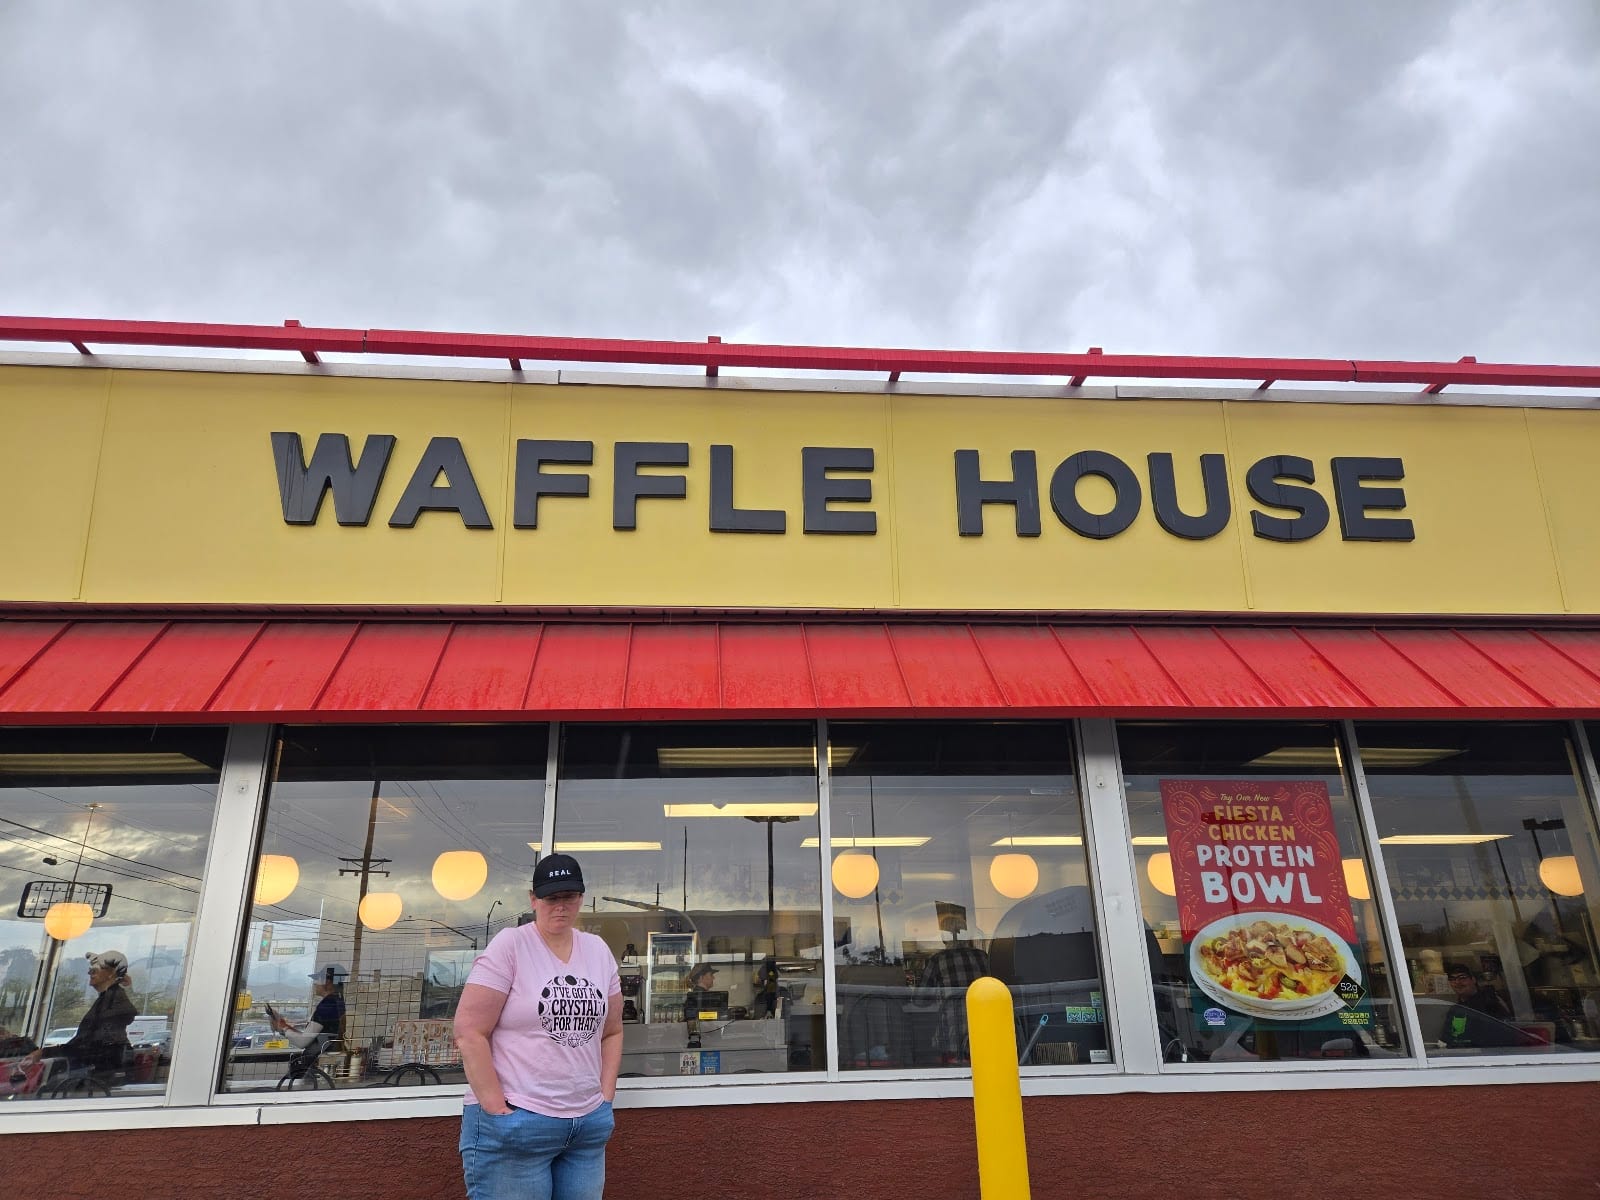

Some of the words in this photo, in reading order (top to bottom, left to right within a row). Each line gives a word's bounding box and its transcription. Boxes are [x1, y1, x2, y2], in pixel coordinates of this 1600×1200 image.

[270, 431, 877, 534] WAFFLE
[954, 449, 1415, 543] HOUSE
[1220, 793, 1233, 804] Try
[1235, 793, 1252, 802] Our
[1254, 793, 1270, 802] New
[1213, 805, 1284, 822] FIESTA
[1208, 824, 1296, 841] CHICKEN
[1196, 845, 1315, 867] PROTEIN
[548, 869, 572, 878] REAL
[1200, 871, 1323, 904] BOWL
[553, 986, 570, 998] I'VE
[571, 987, 588, 999] GOT
[588, 988, 597, 1000] A
[1340, 982, 1358, 994] 52g
[551, 999, 599, 1016] CRYSTAL
[552, 1016, 571, 1031] FOR
[573, 1016, 596, 1031] THAT
